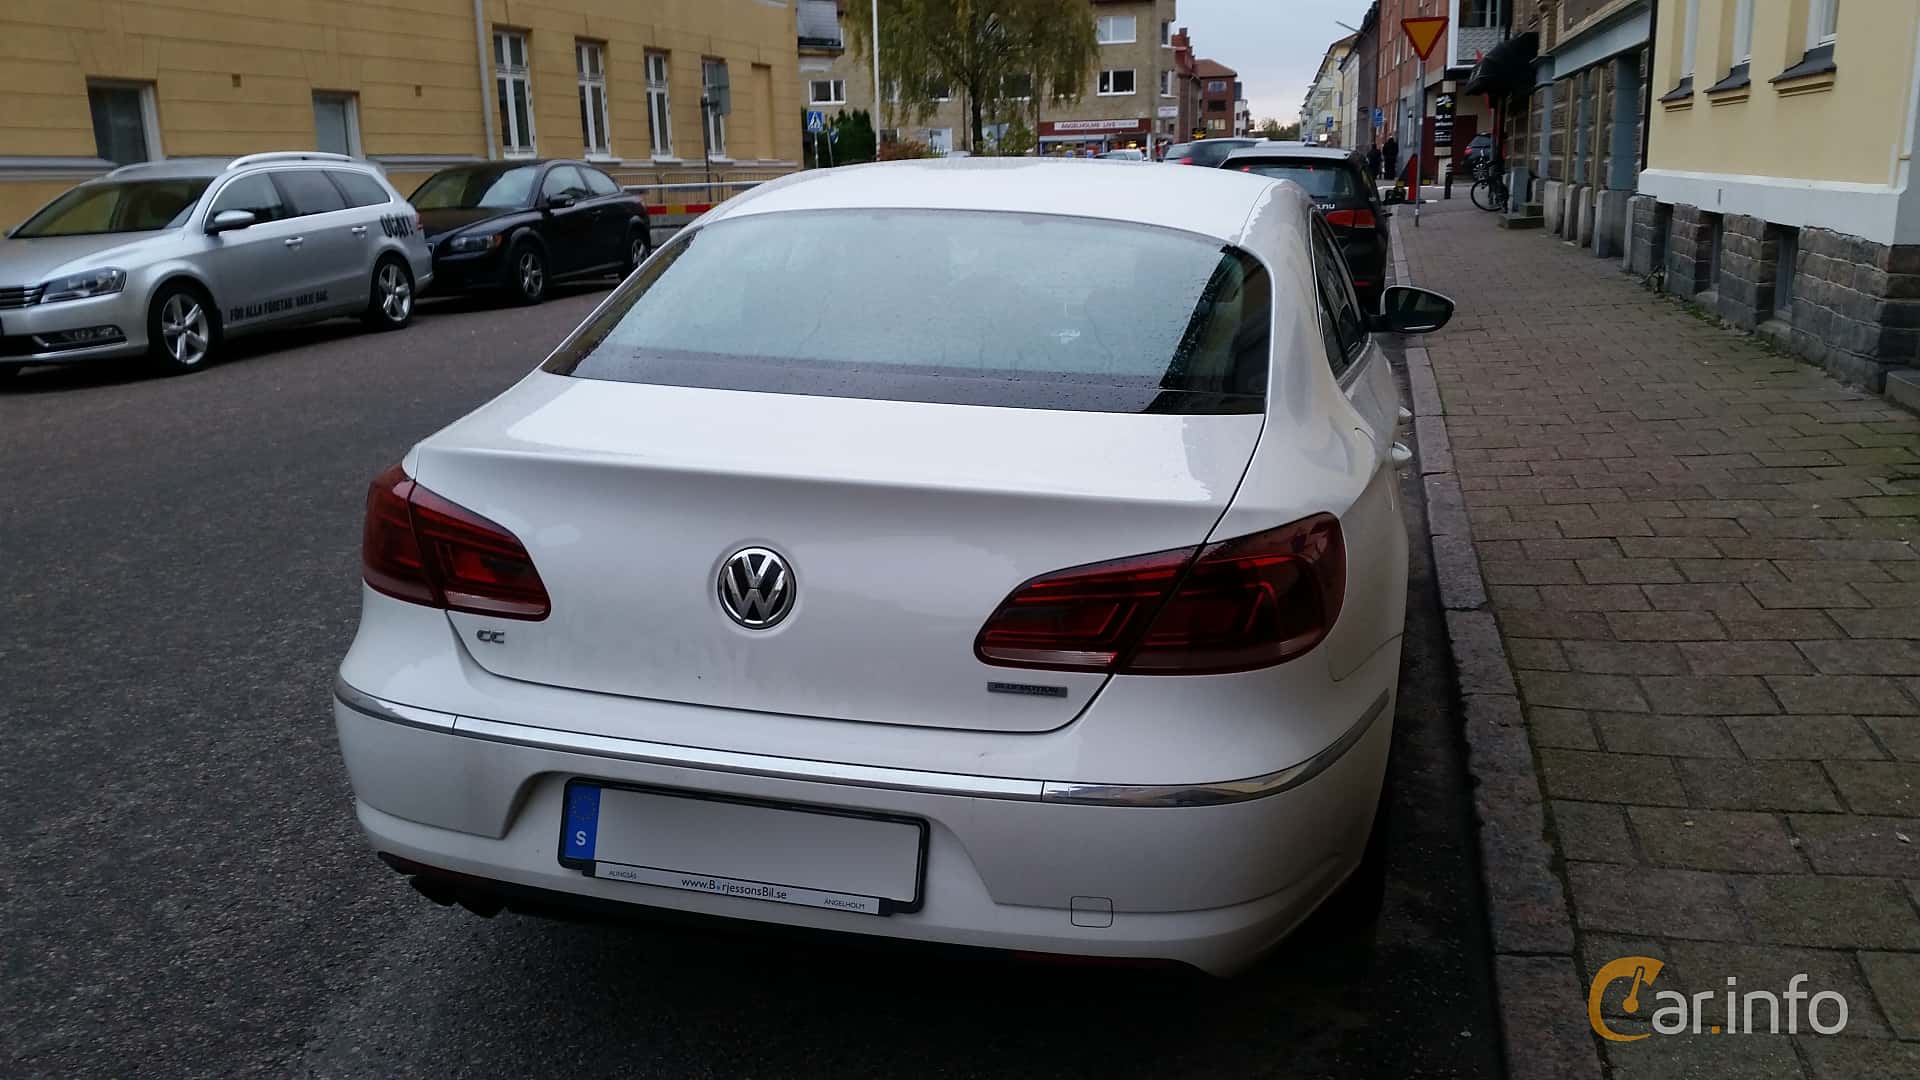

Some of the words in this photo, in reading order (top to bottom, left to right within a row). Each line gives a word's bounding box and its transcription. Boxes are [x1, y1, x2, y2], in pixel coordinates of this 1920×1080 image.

[246, 303, 262, 317] ALLA
[719, 547, 794, 628] VW
[477, 630, 504, 643] CC
[575, 831, 587, 846] S
